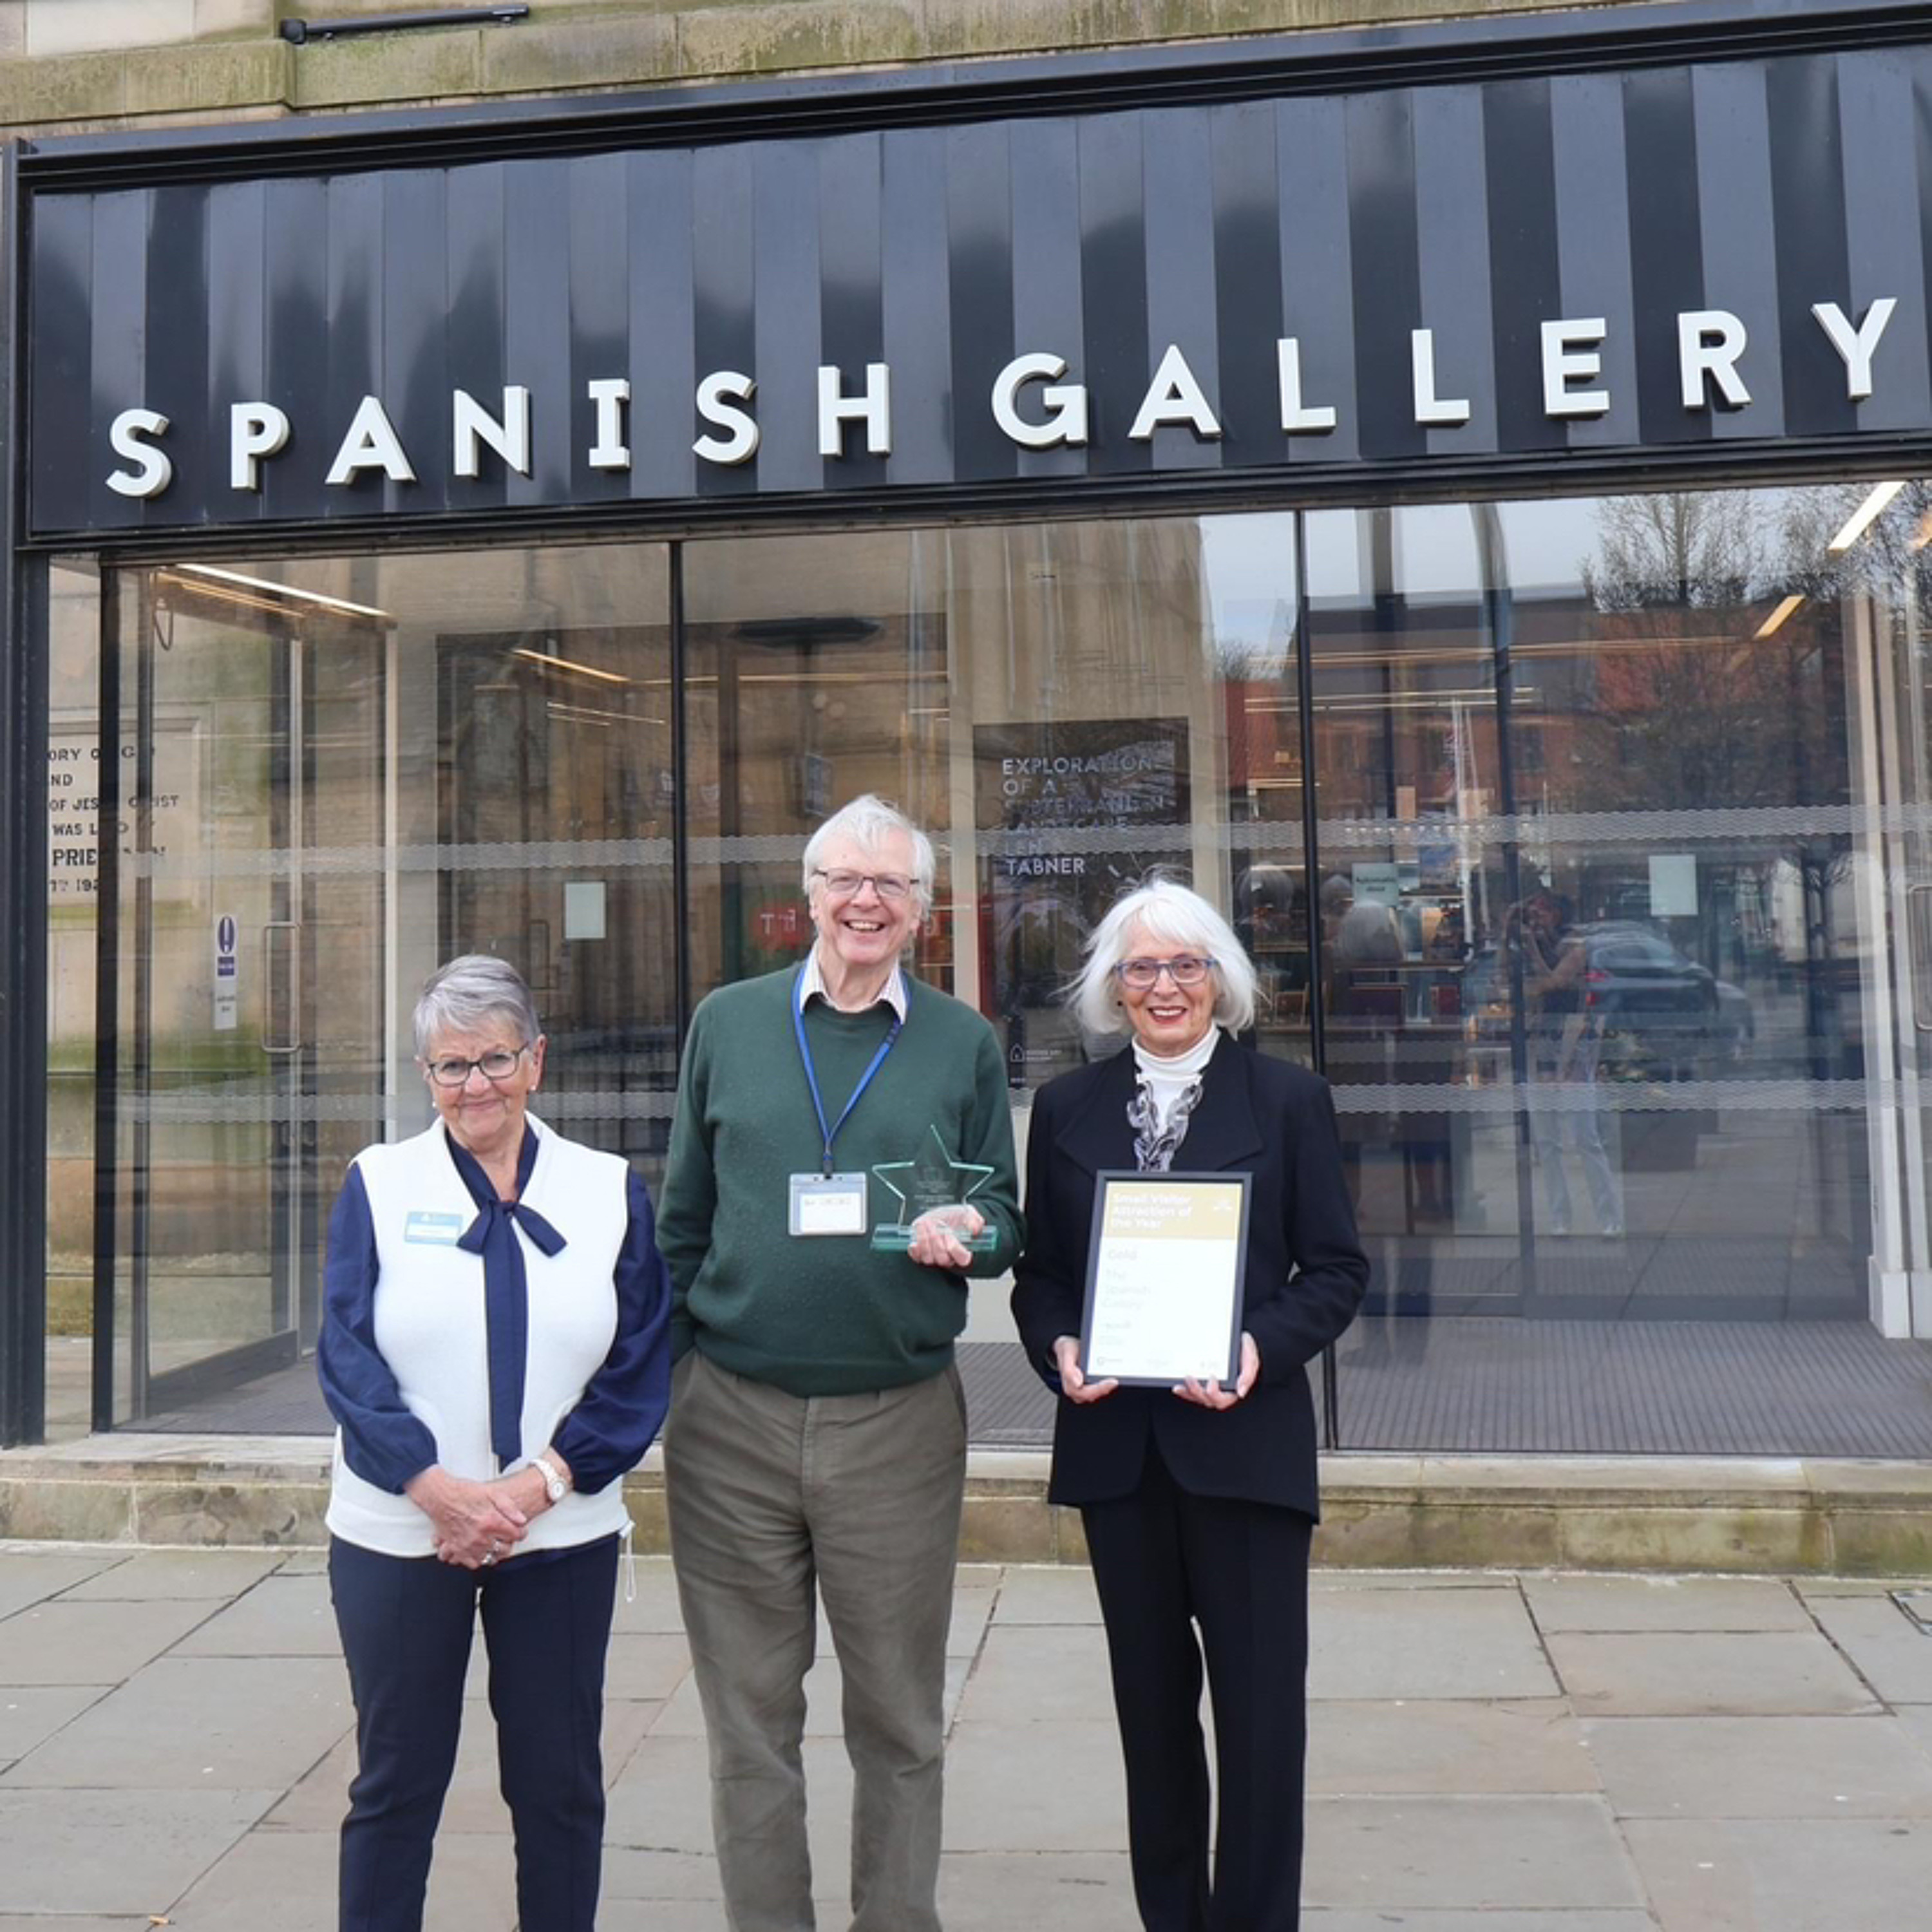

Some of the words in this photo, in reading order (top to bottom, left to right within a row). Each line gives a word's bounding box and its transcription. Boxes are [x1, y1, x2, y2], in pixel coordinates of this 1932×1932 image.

[104, 363, 891, 498] SPANISH
[991, 298, 1897, 450] GALLERY
[1003, 779, 1031, 795] OF
[1042, 779, 1057, 794] A
[50, 799, 66, 811] OF
[129, 795, 179, 810] CIST
[1005, 796, 1164, 815] SBTERANEN
[53, 823, 82, 836] WAS
[1006, 816, 1128, 835] LANDCAPE
[1005, 858, 1086, 876] TABNER
